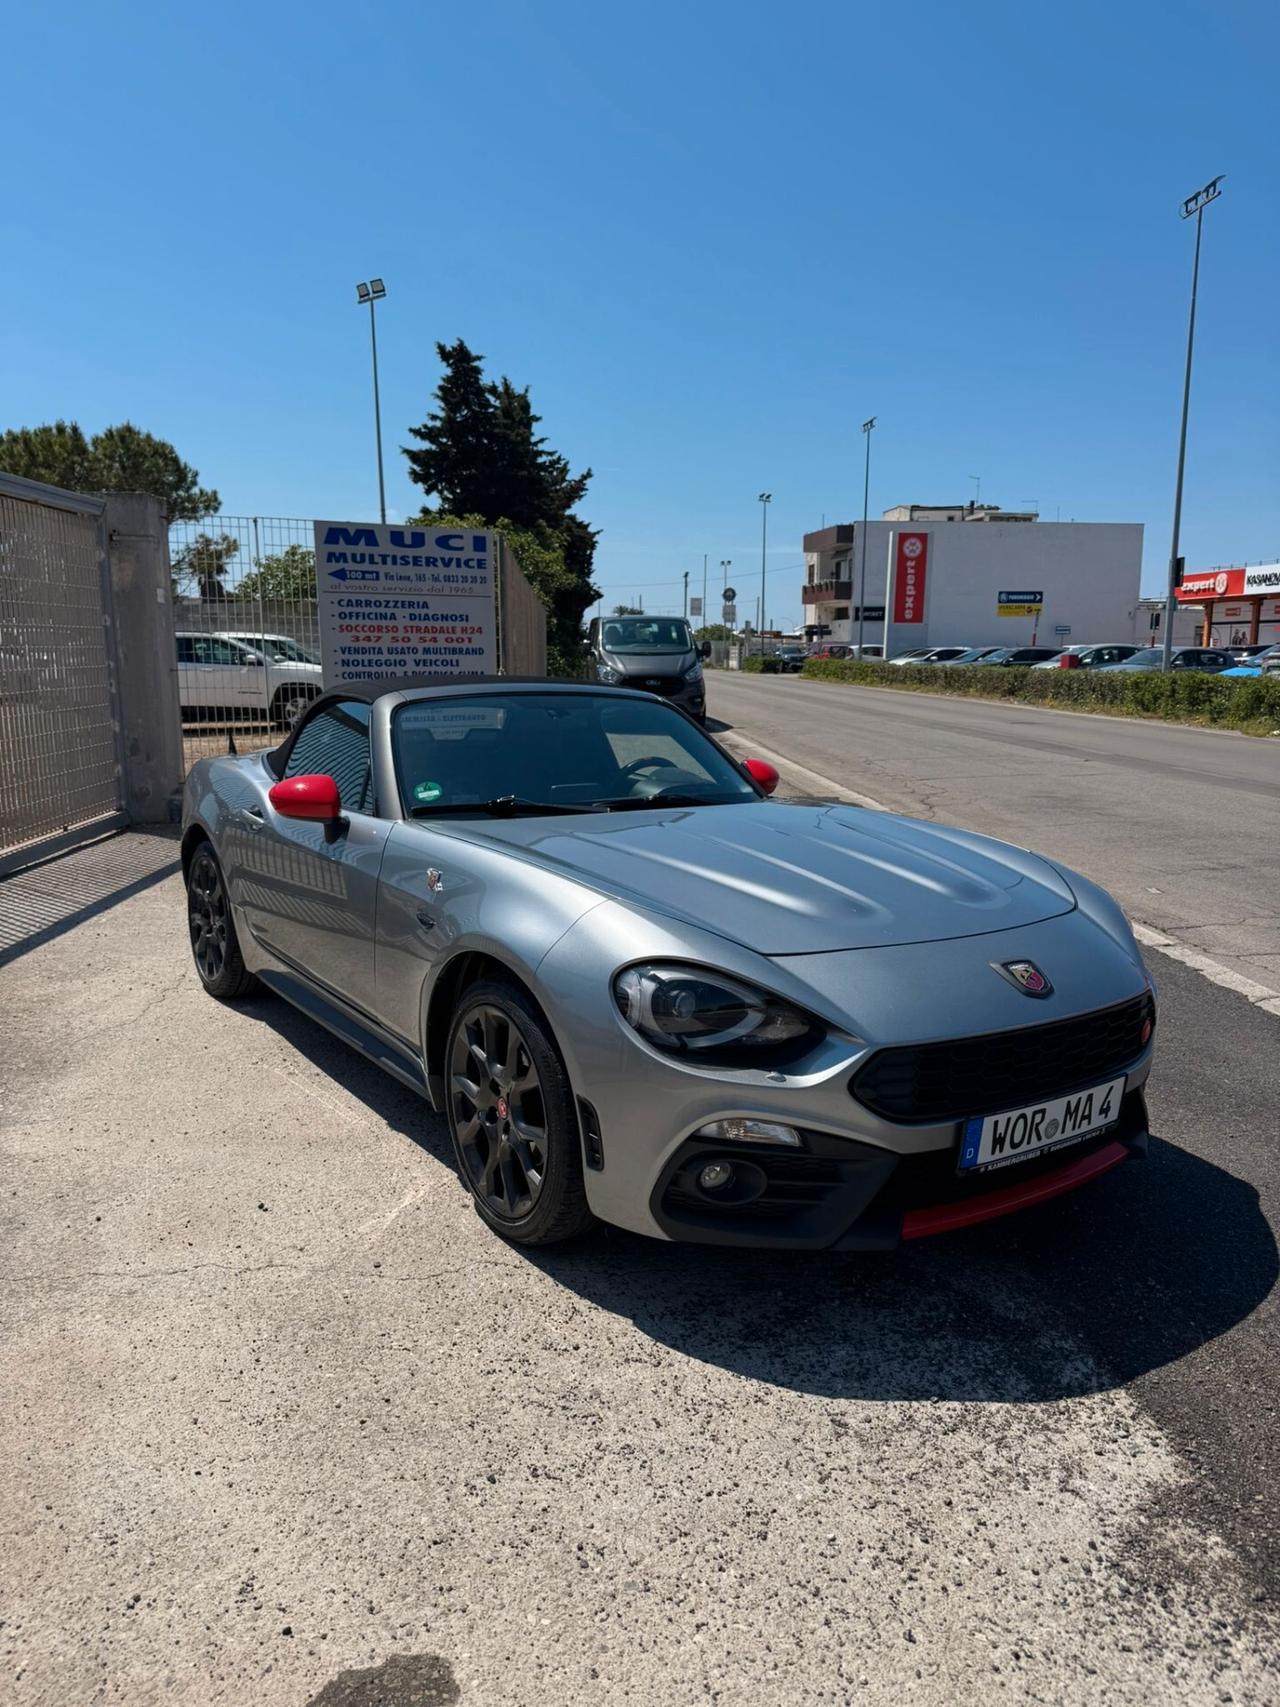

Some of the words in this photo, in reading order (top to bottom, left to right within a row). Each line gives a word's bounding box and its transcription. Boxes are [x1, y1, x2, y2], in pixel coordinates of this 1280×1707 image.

[324, 527, 487, 552] MUCI
[326, 551, 487, 569] MULTISERVICE
[346, 571, 363, 579] 100
[1247, 572, 1280, 587] KASANOV
[330, 582, 342, 590] al
[382, 585, 423, 593] servizio
[427, 585, 444, 593] dal
[904, 560, 917, 619] expert
[1181, 578, 1215, 592] expert
[337, 599, 429, 609] CARROZZERIA
[338, 611, 398, 621] OFFICINA
[409, 613, 469, 623] DIAGNOSI
[338, 624, 399, 633] SOCCORSO
[403, 625, 457, 634] STRADALE
[461, 626, 483, 635] H24
[351, 635, 382, 643] 347
[419, 636, 438, 644] 54
[444, 636, 473, 644] 001
[340, 646, 384, 655] VENDITA
[387, 646, 418, 655] USATO
[422, 646, 485, 655] MULTIBRAND
[341, 658, 407, 667] NOLEGGIO
[414, 658, 459, 668] VEICOLI
[991, 1108, 1046, 1156] WOR
[1061, 1093, 1094, 1135] MA
[1098, 1085, 1114, 1119] 4
[966, 1149, 974, 1159] D
